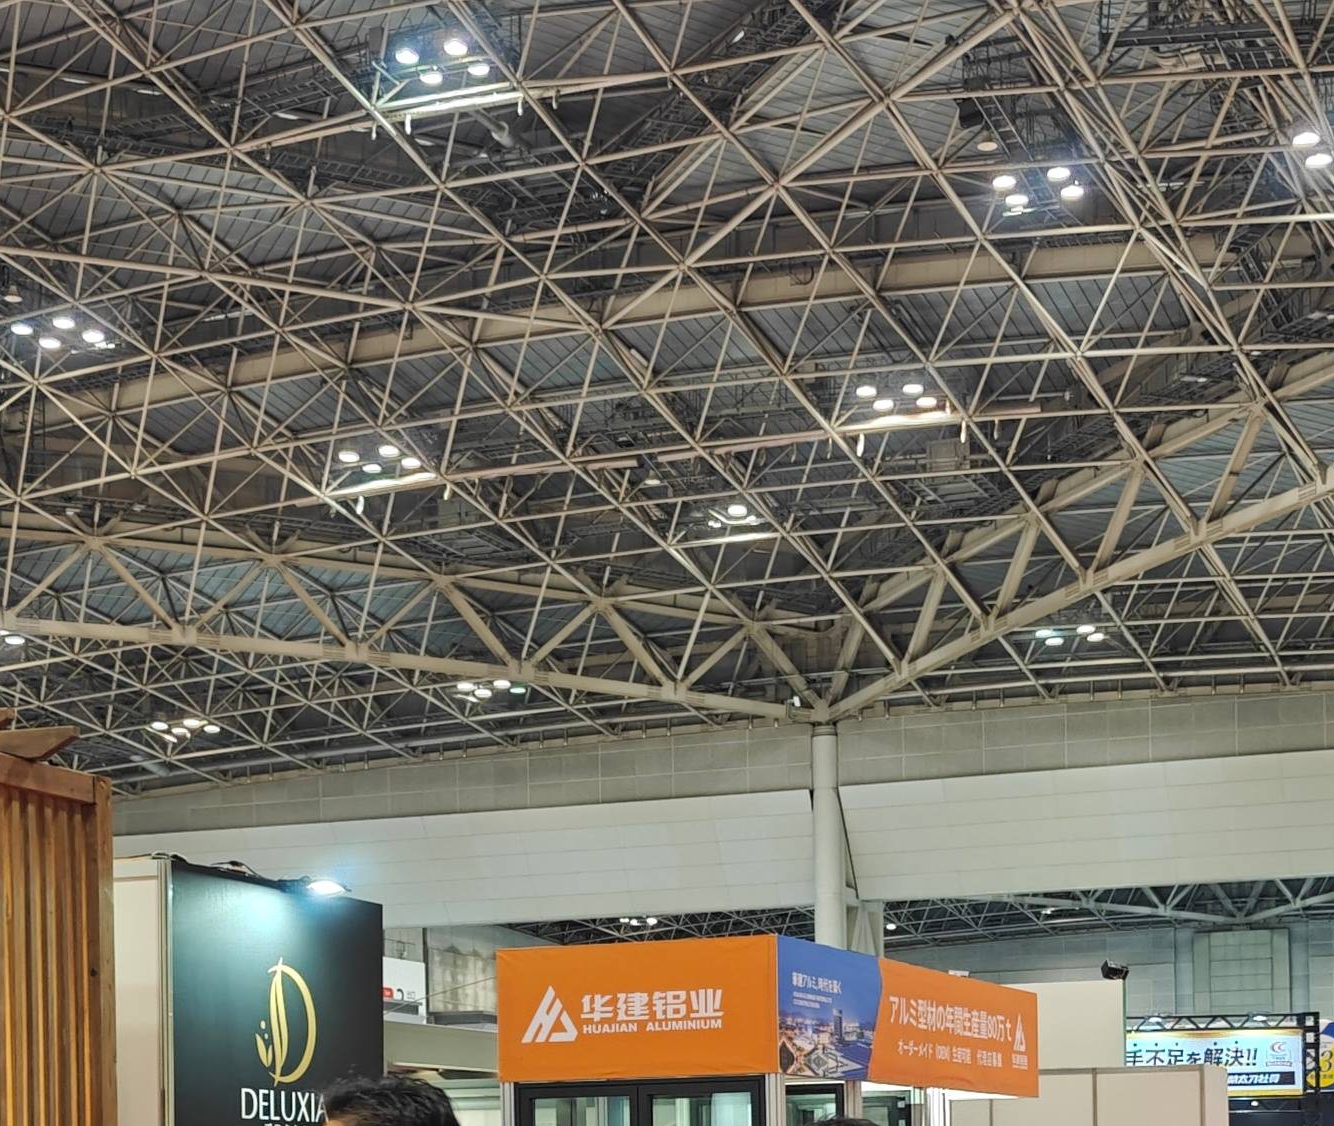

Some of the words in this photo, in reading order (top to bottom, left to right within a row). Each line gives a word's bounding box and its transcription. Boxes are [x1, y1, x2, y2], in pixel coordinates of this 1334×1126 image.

[580, 988, 725, 1023] 华建铝业
[582, 1022, 638, 1035] HUAJIAN
[646, 1019, 723, 1032] ALUMINIUM
[241, 1087, 330, 1123] DELUXIA
